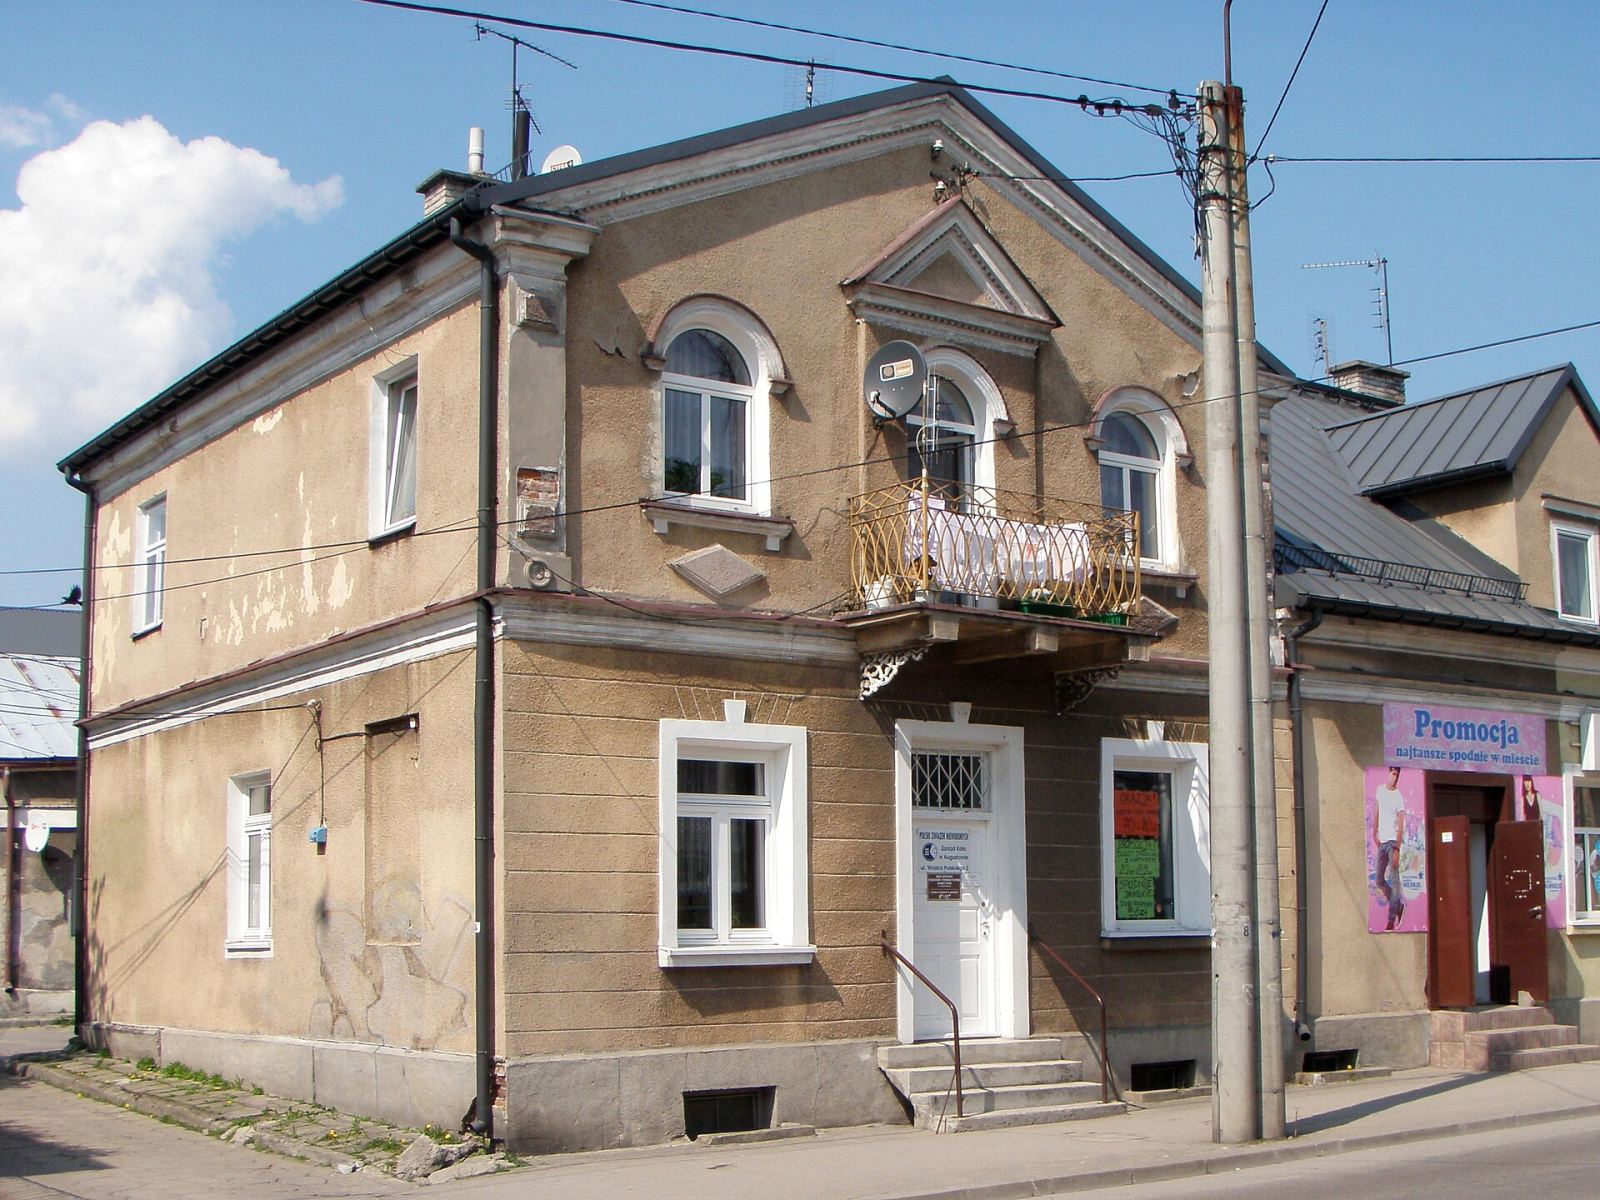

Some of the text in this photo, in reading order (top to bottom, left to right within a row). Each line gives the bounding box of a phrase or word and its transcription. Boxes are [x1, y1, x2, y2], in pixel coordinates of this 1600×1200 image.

[1414, 709, 1519, 750] Promocja
[1396, 745, 1540, 766] najtansze spodnie w miescie
[1243, 925, 1250, 937] 8
